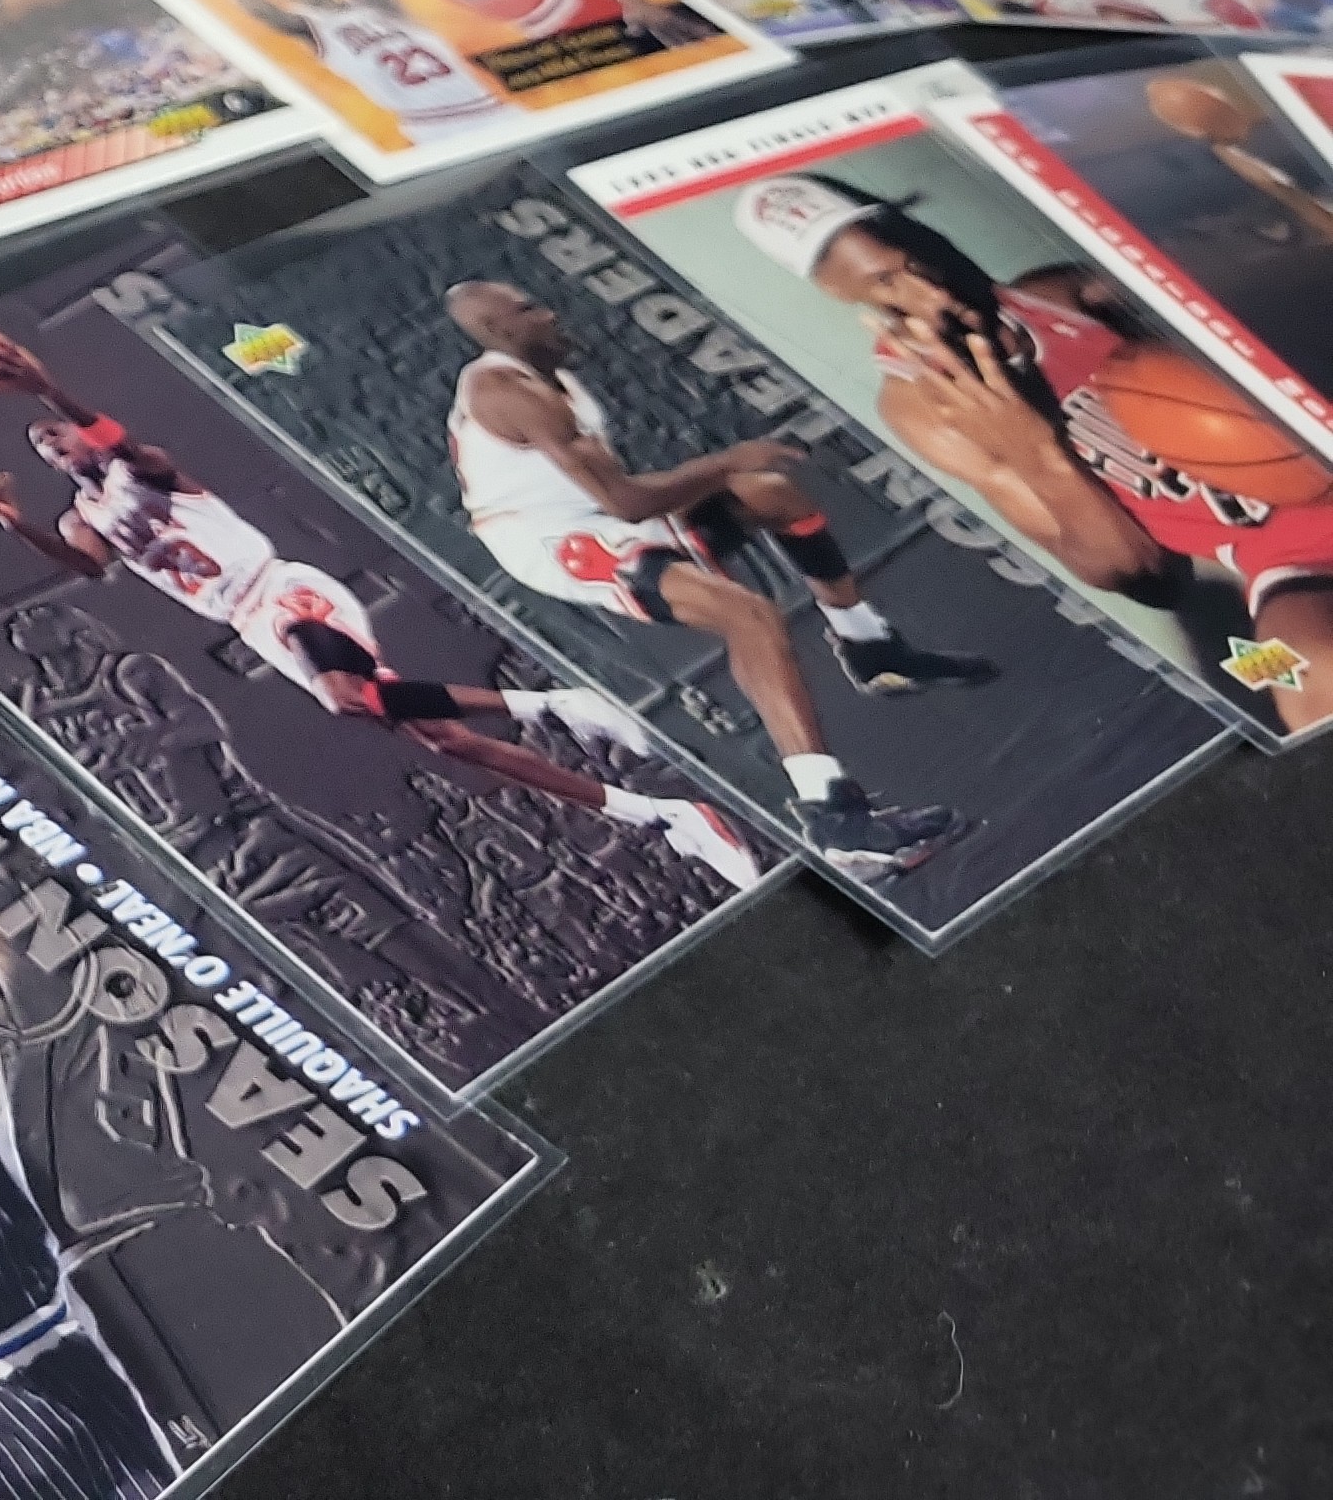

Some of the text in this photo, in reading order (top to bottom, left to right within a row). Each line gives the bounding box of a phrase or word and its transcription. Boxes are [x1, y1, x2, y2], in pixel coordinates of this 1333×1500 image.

[0, 799, 88, 869] NBA
[90, 877, 232, 989] O'NEAL
[213, 979, 421, 1141] SHAQUILLE
